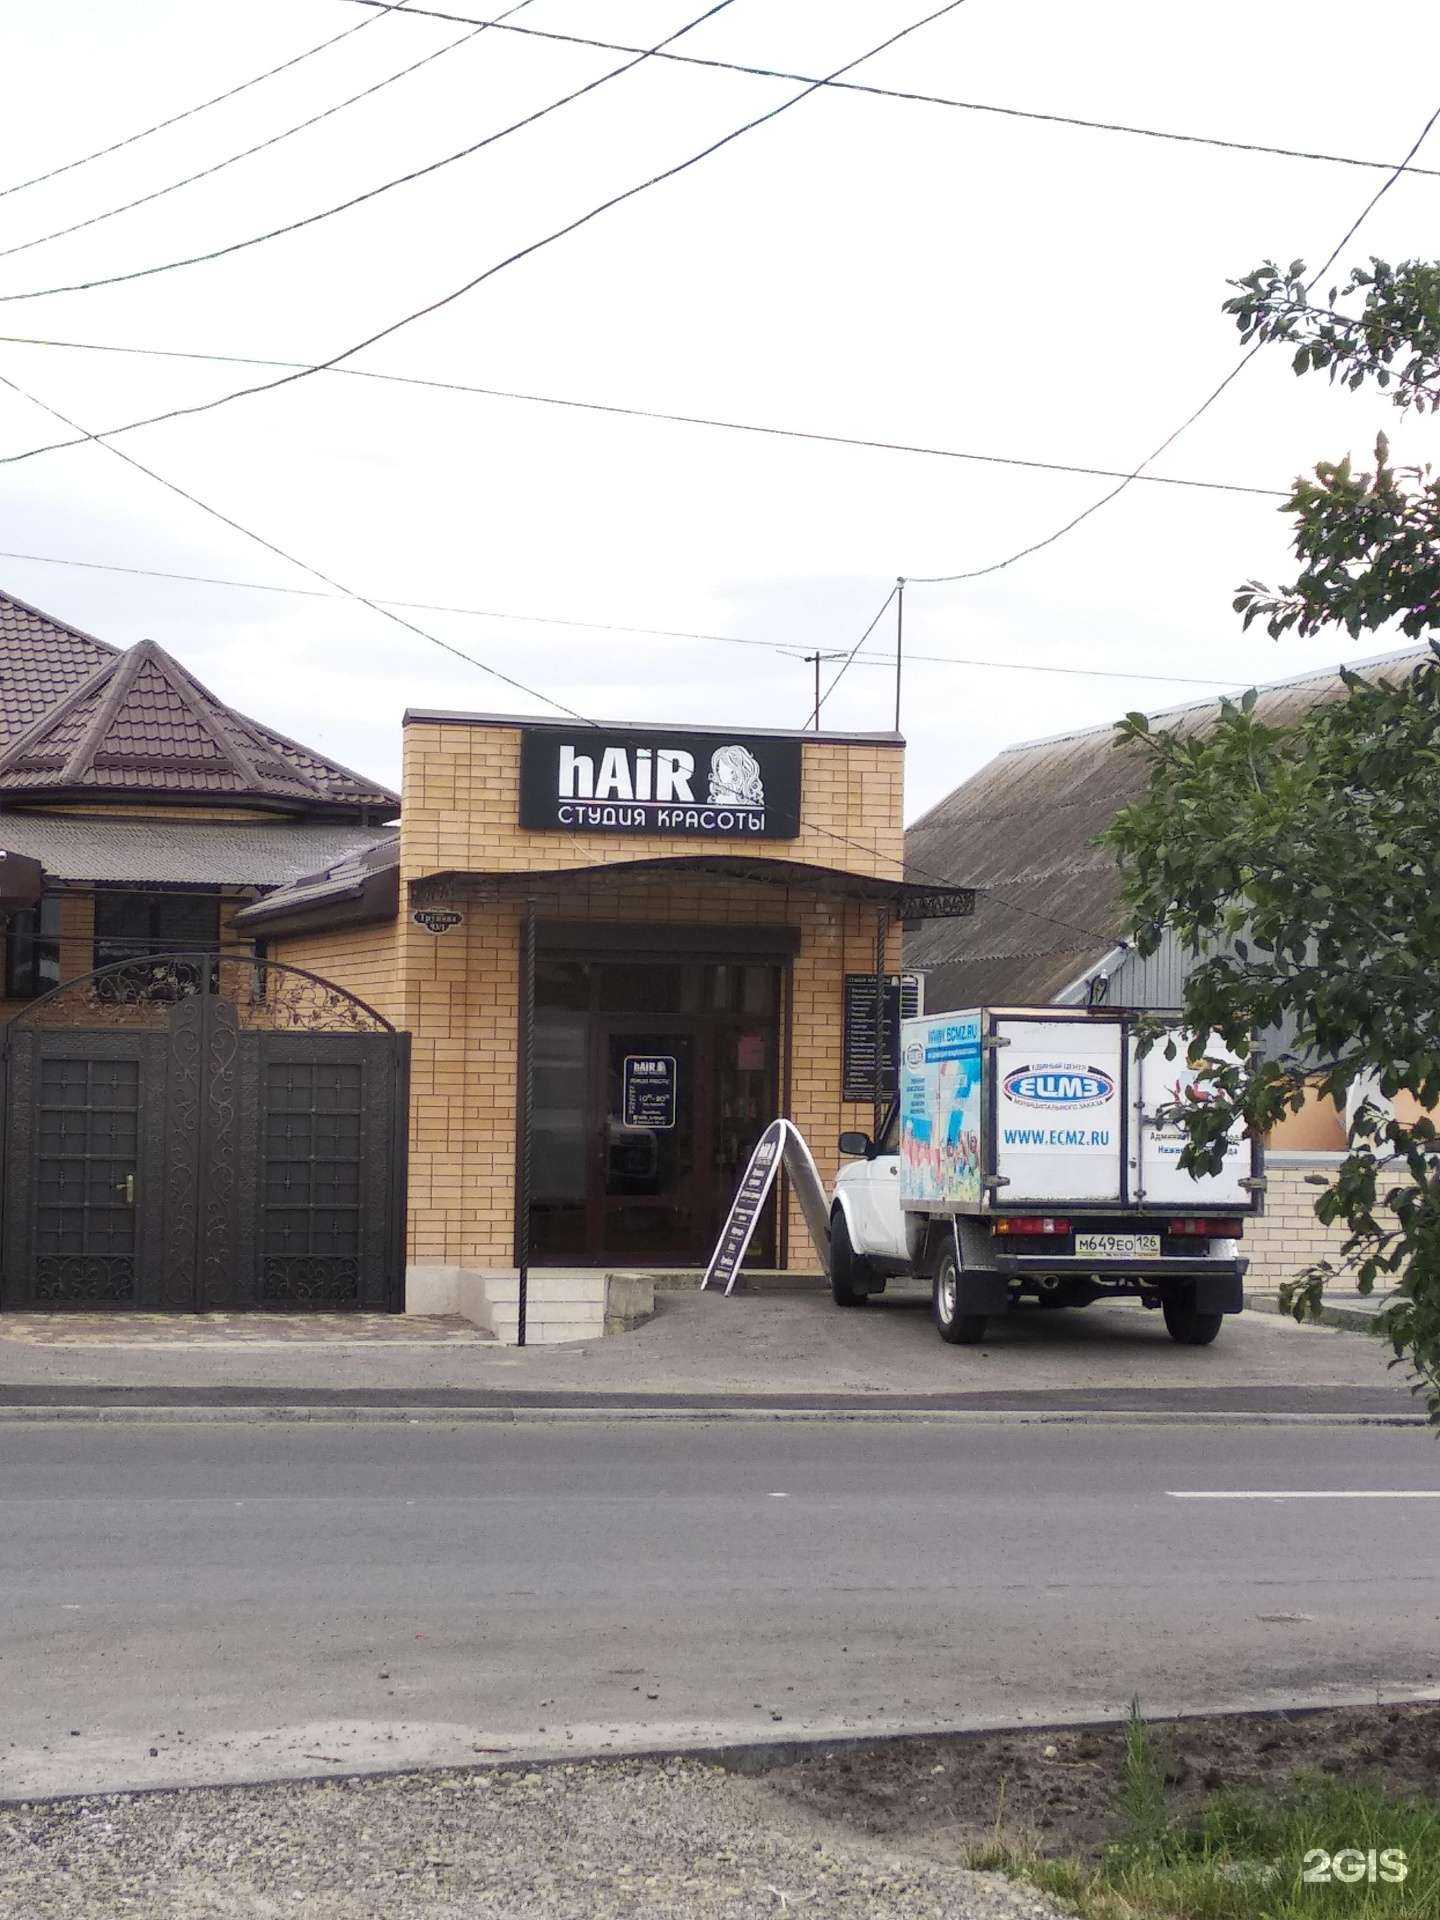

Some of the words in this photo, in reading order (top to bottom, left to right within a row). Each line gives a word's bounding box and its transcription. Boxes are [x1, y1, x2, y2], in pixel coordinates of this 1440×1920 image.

[558, 806, 646, 826] СТУДИЯ
[658, 808, 765, 830] КРАСОТЫ
[1019, 1077, 1100, 1097] ЕЦМЗ
[1004, 1129, 1109, 1146] WWW.ECMZ.RU
